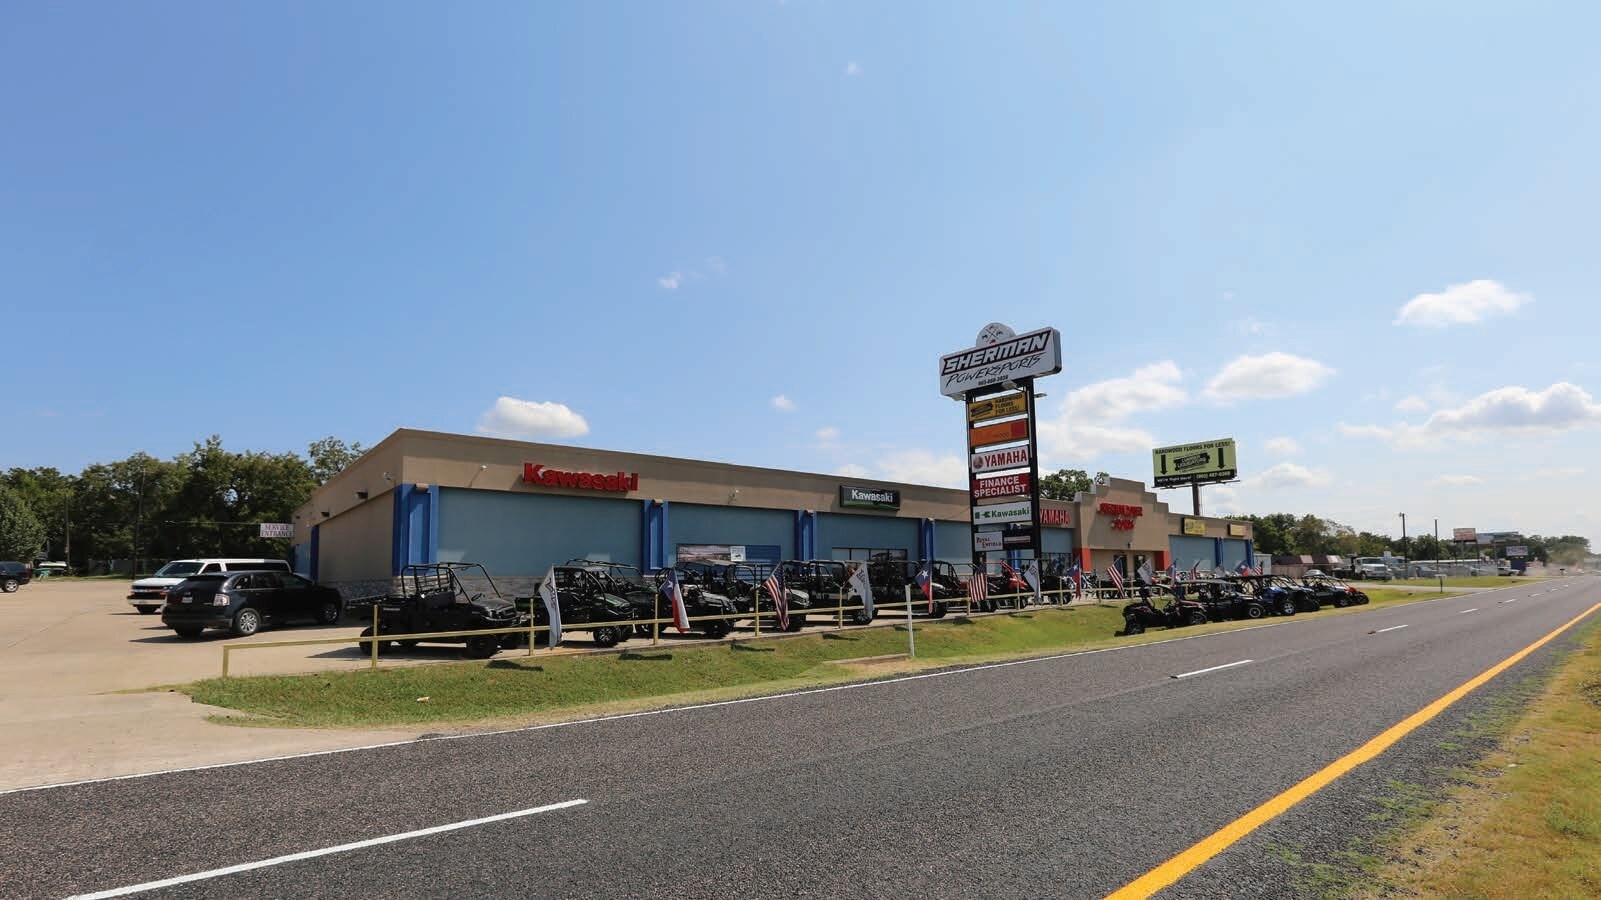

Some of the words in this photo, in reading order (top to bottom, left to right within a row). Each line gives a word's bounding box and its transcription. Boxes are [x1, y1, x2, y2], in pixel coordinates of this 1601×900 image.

[942, 330, 1051, 376] SHERMAN
[945, 352, 1046, 388] POWERSPORTS
[995, 401, 1013, 410] FLOORS
[1155, 447, 1182, 455] HARDWOOD
[985, 449, 1027, 468] YAMAHA
[524, 463, 639, 491] Kawasaki
[980, 476, 1019, 489] FINANCE
[851, 489, 893, 503] Kawasaki
[974, 484, 1027, 498] SPECIALIST
[991, 506, 1029, 518] Kawasaki
[1040, 508, 1071, 525] YAMAHA
